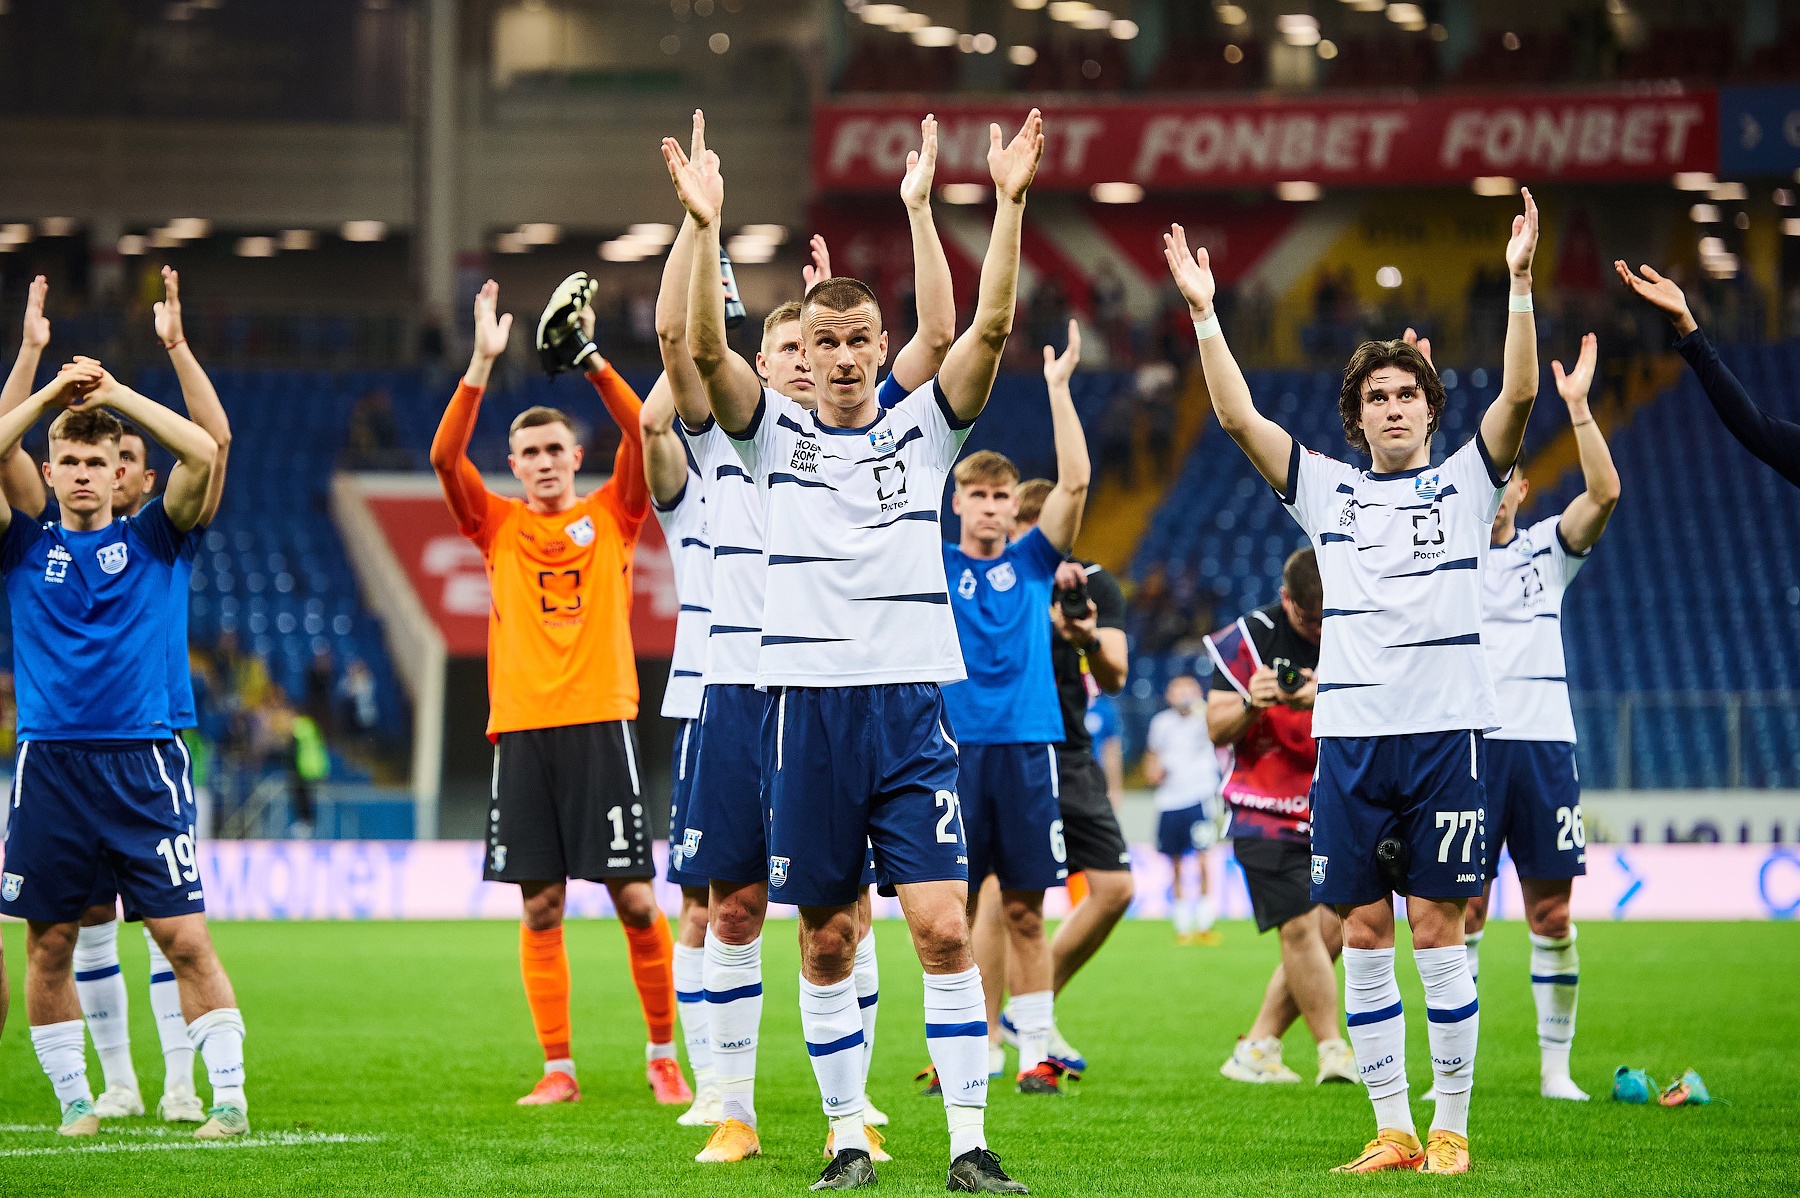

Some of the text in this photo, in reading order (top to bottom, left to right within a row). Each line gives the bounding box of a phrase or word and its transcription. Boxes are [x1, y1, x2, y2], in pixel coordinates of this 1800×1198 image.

[1132, 112, 1408, 178] FONBET
[1442, 104, 1702, 172] FONBET
[789, 458, 818, 474] БАНК
[792, 449, 816, 462] КОМ
[606, 805, 630, 851] 1
[1049, 819, 1067, 863] 6
[1435, 810, 1477, 863] 77
[1556, 804, 1586, 851] 26
[155, 833, 199, 887] 19
[1455, 873, 1477, 883] JAKO
[720, 1037, 751, 1049] JAKO
[1360, 1054, 1394, 1075] JAKO
